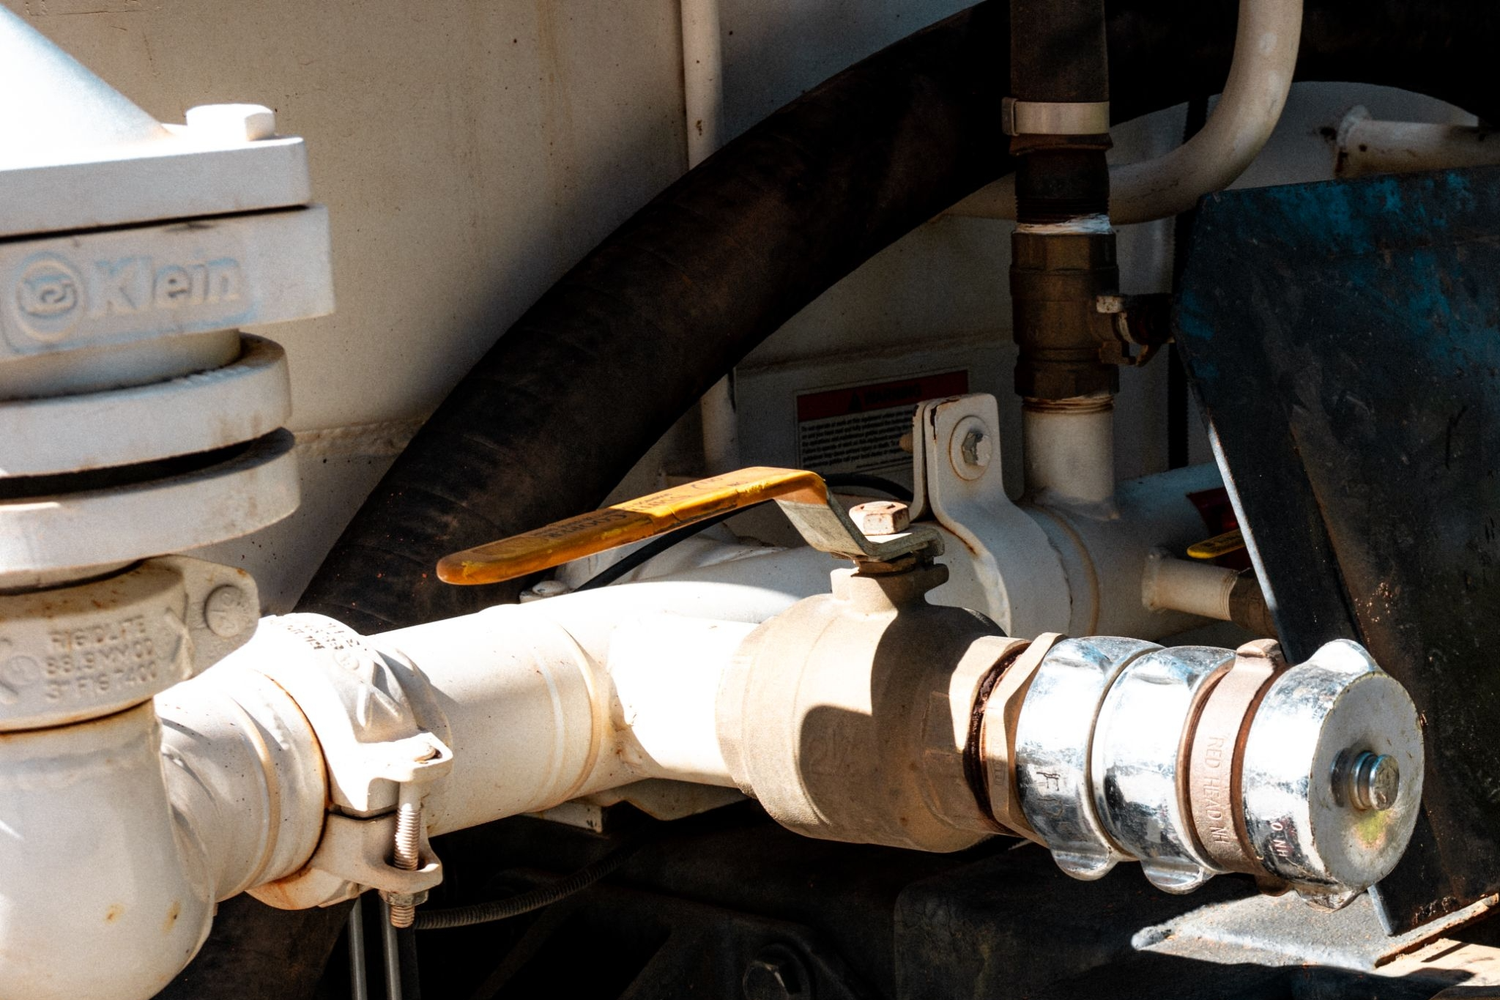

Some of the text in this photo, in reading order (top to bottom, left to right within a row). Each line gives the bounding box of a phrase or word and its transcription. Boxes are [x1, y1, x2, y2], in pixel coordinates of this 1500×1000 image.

[89, 249, 242, 318] Klein
[865, 383, 922, 404] WARNING
[1202, 736, 1231, 844] RED HEAD NH
